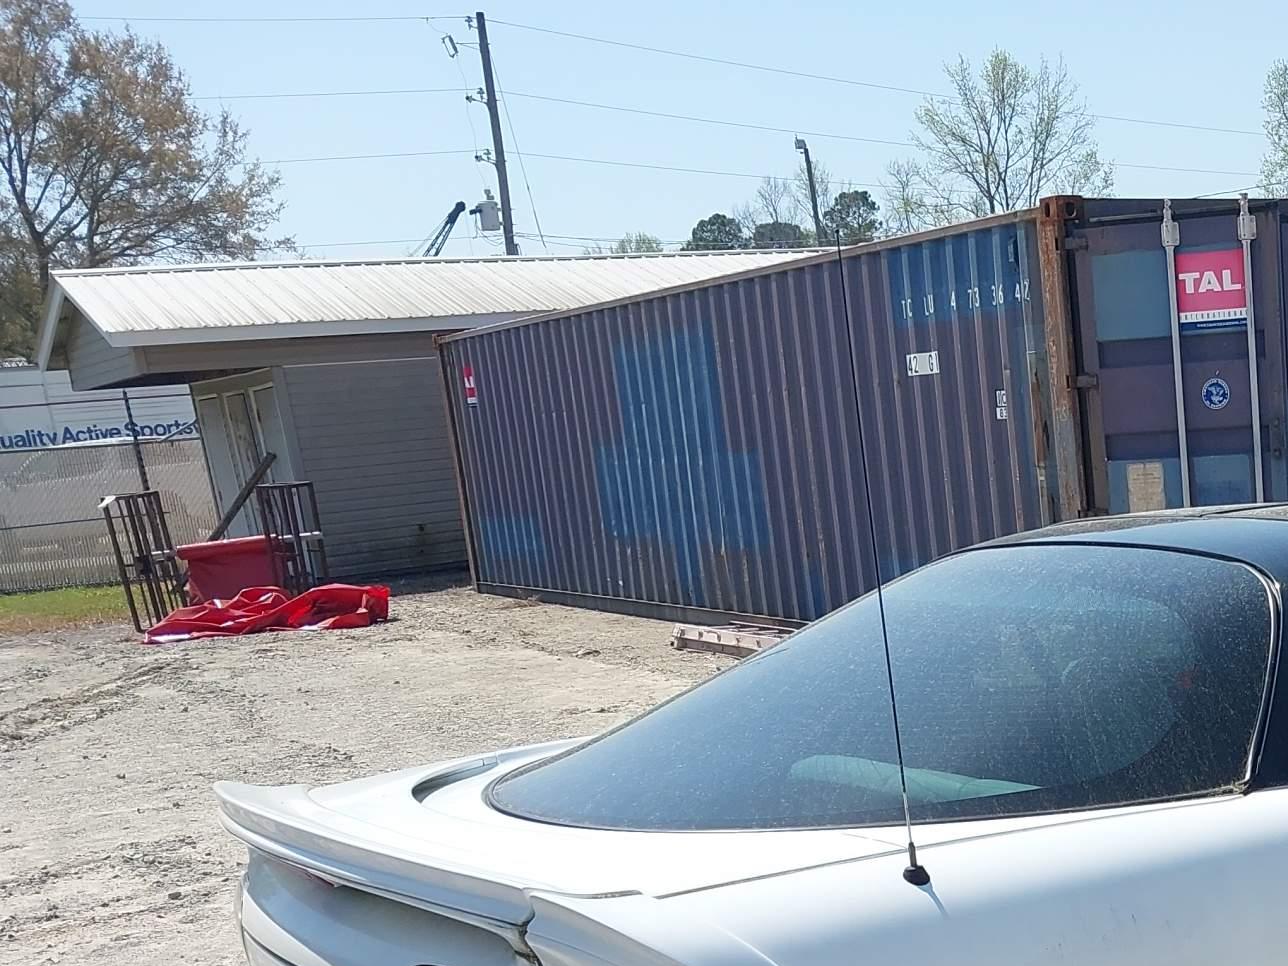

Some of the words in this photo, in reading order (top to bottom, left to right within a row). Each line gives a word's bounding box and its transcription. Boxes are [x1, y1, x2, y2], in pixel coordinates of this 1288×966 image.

[1178, 269, 1242, 294] TAL
[0, 429, 57, 449] uality
[62, 424, 121, 443] Active
